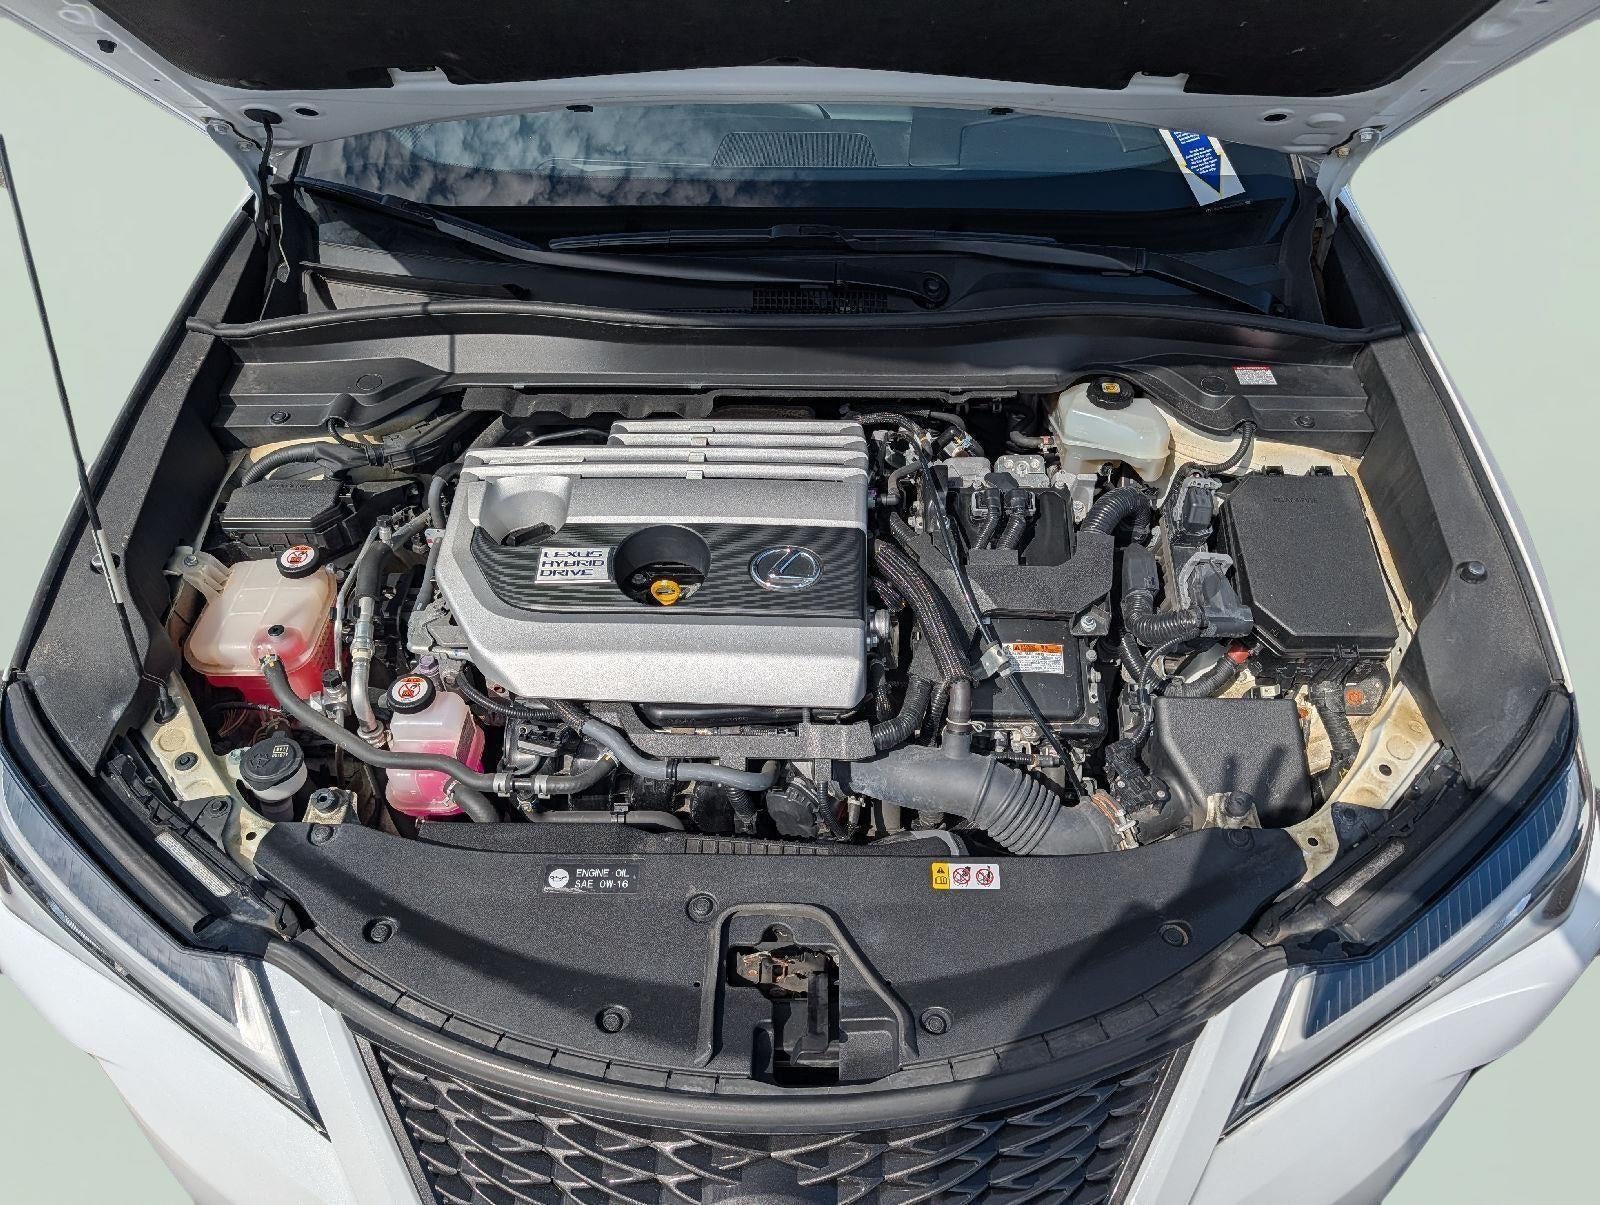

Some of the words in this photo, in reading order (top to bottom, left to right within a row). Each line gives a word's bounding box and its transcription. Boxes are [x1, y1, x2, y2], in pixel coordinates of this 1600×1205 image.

[540, 569, 593, 577] DRIVE
[576, 868, 609, 877] ENGINE
[615, 868, 629, 877] OIL
[575, 880, 593, 888] SAE
[600, 880, 628, 889] 0W-16
